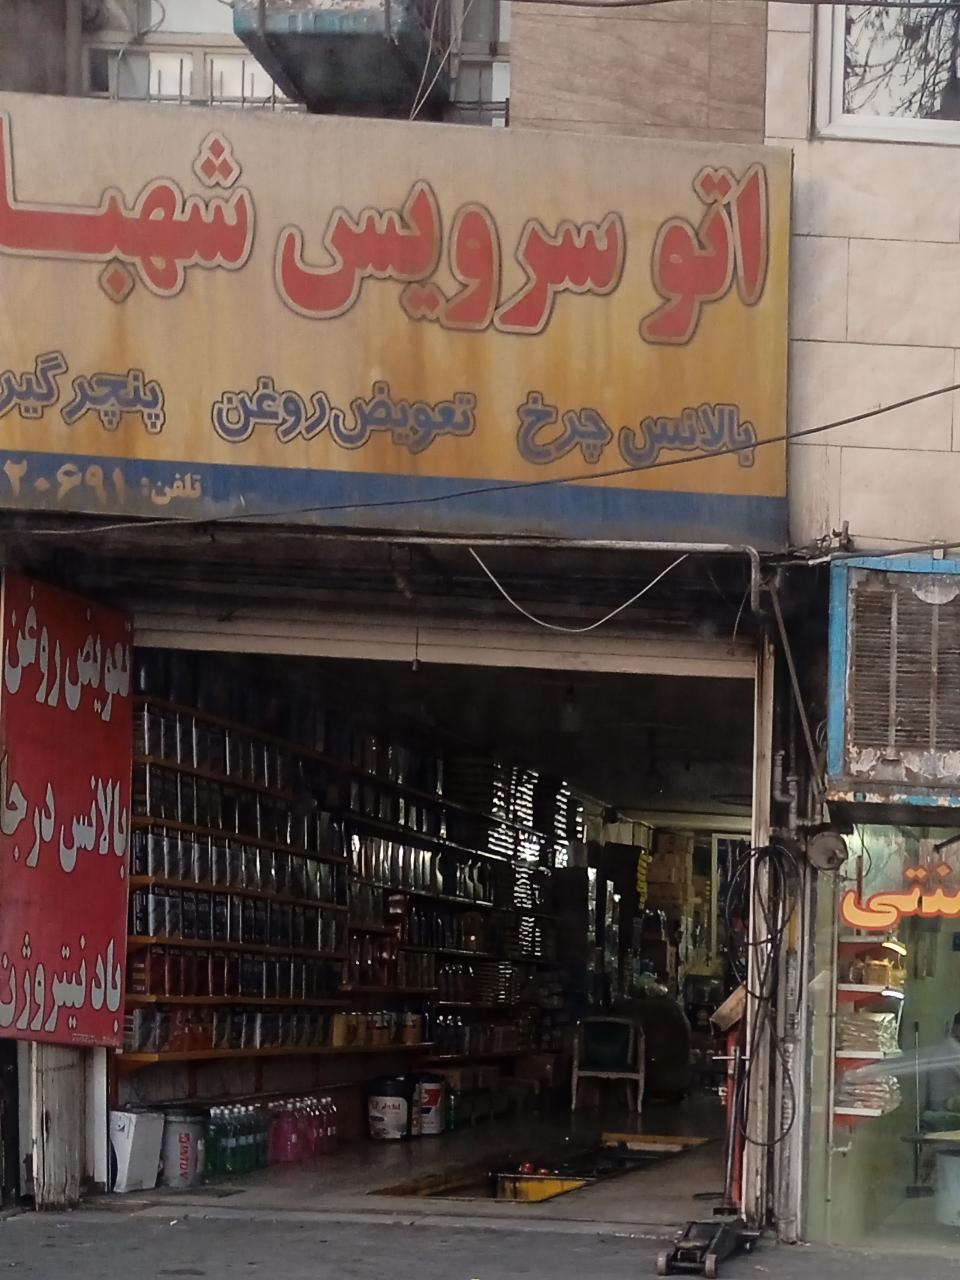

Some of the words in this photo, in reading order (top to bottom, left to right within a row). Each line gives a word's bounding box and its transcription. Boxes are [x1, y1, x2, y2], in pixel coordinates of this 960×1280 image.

[276, 180, 623, 335] سرویس
[641, 164, 767, 343] اتو
[212, 376, 331, 443] روغن
[330, 381, 476, 455] تعویض
[517, 391, 613, 464] چرخ
[618, 403, 757, 467] بالانس
[5, 585, 61, 707] روغن
[65, 608, 131, 721] تعویض
[60, 775, 127, 879] بالانس
[0, 932, 86, 1032] نیتروژن
[91, 937, 121, 1033] باد
